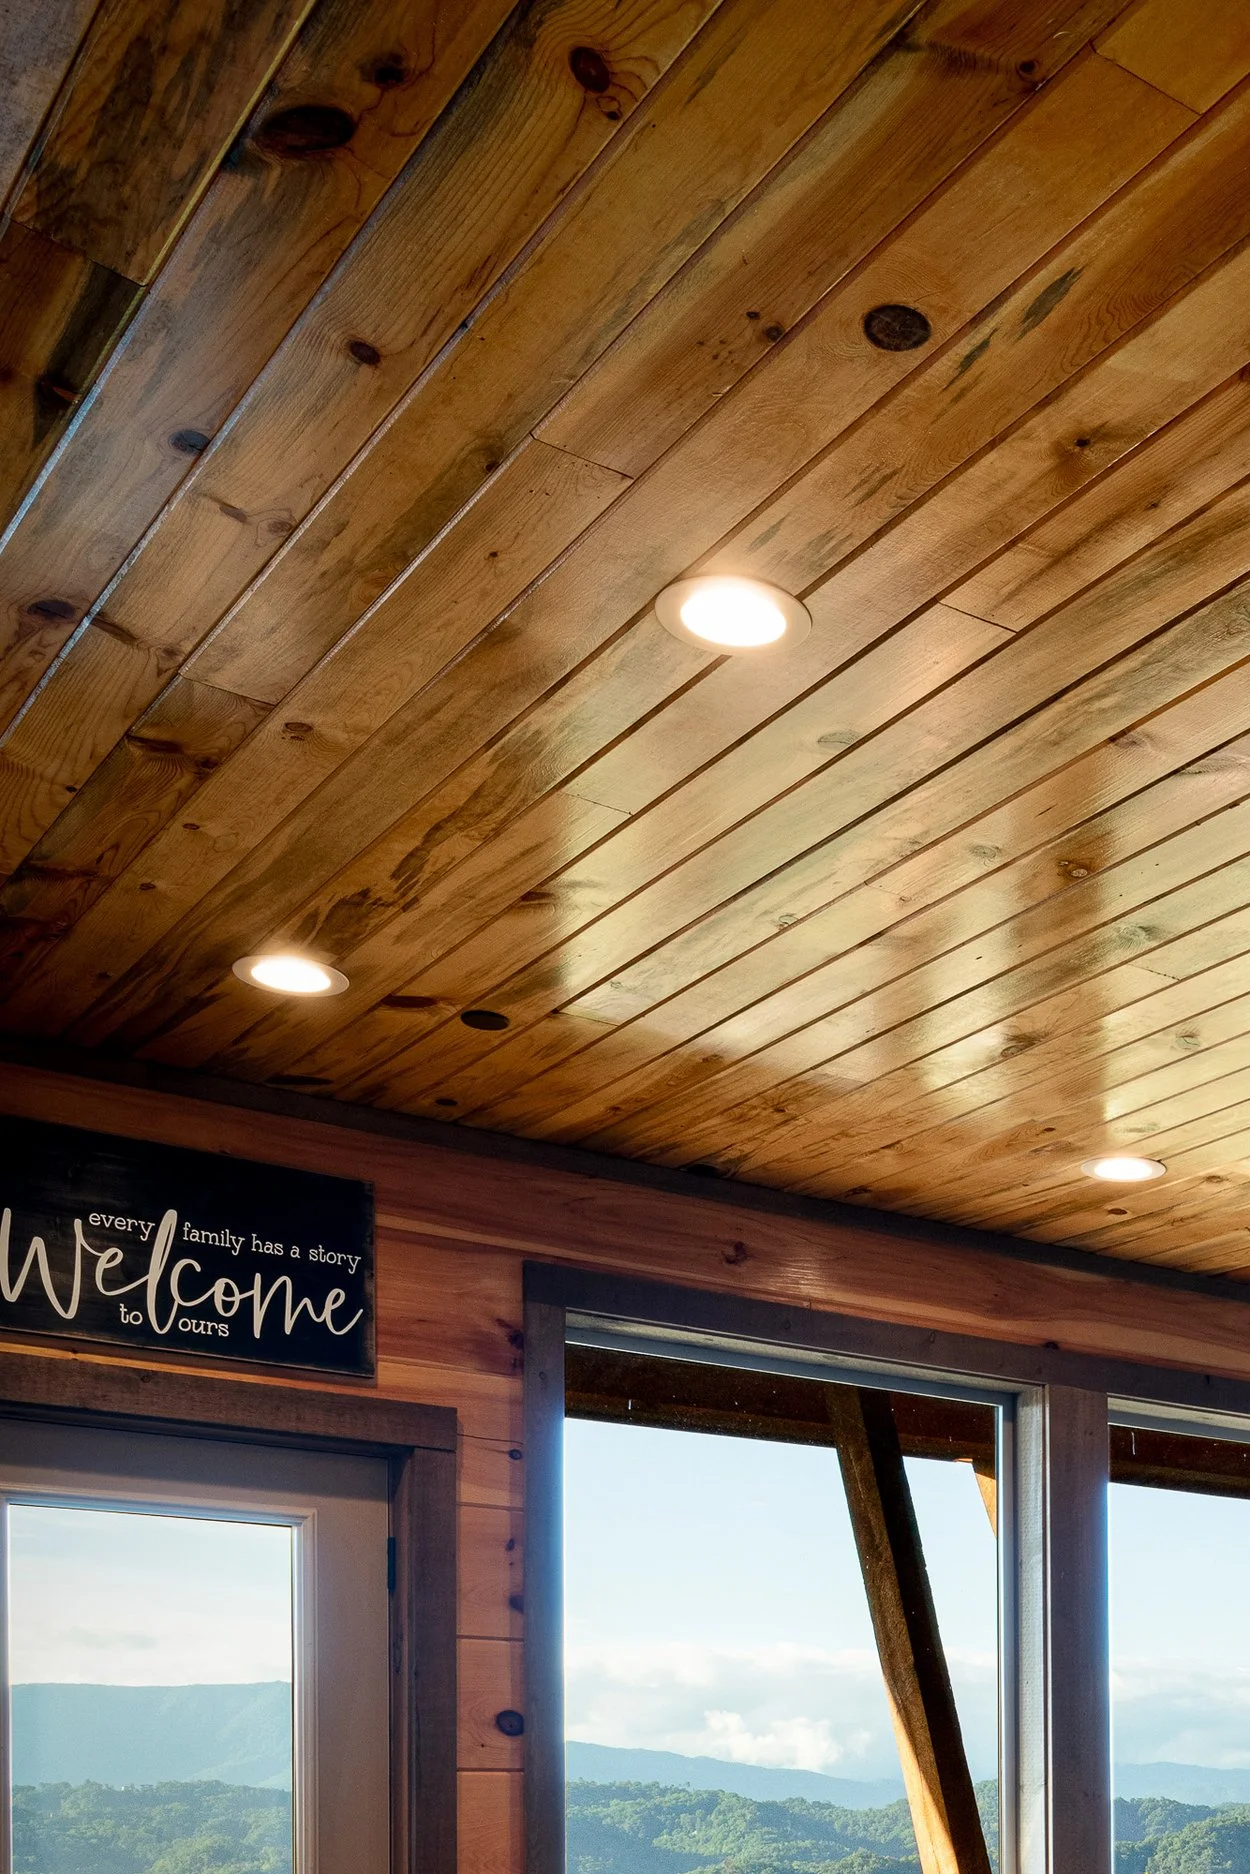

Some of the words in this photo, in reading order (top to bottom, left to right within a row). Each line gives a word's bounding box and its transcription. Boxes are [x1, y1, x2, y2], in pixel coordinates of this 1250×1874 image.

[0, 1207, 364, 1339] Welcome
[88, 1212, 156, 1242] every
[182, 1221, 246, 1256] family
[251, 1233, 284, 1256] has
[290, 1245, 301, 1259] a
[308, 1244, 362, 1275] story
[119, 1302, 144, 1325] to
[178, 1317, 230, 1337] ours
